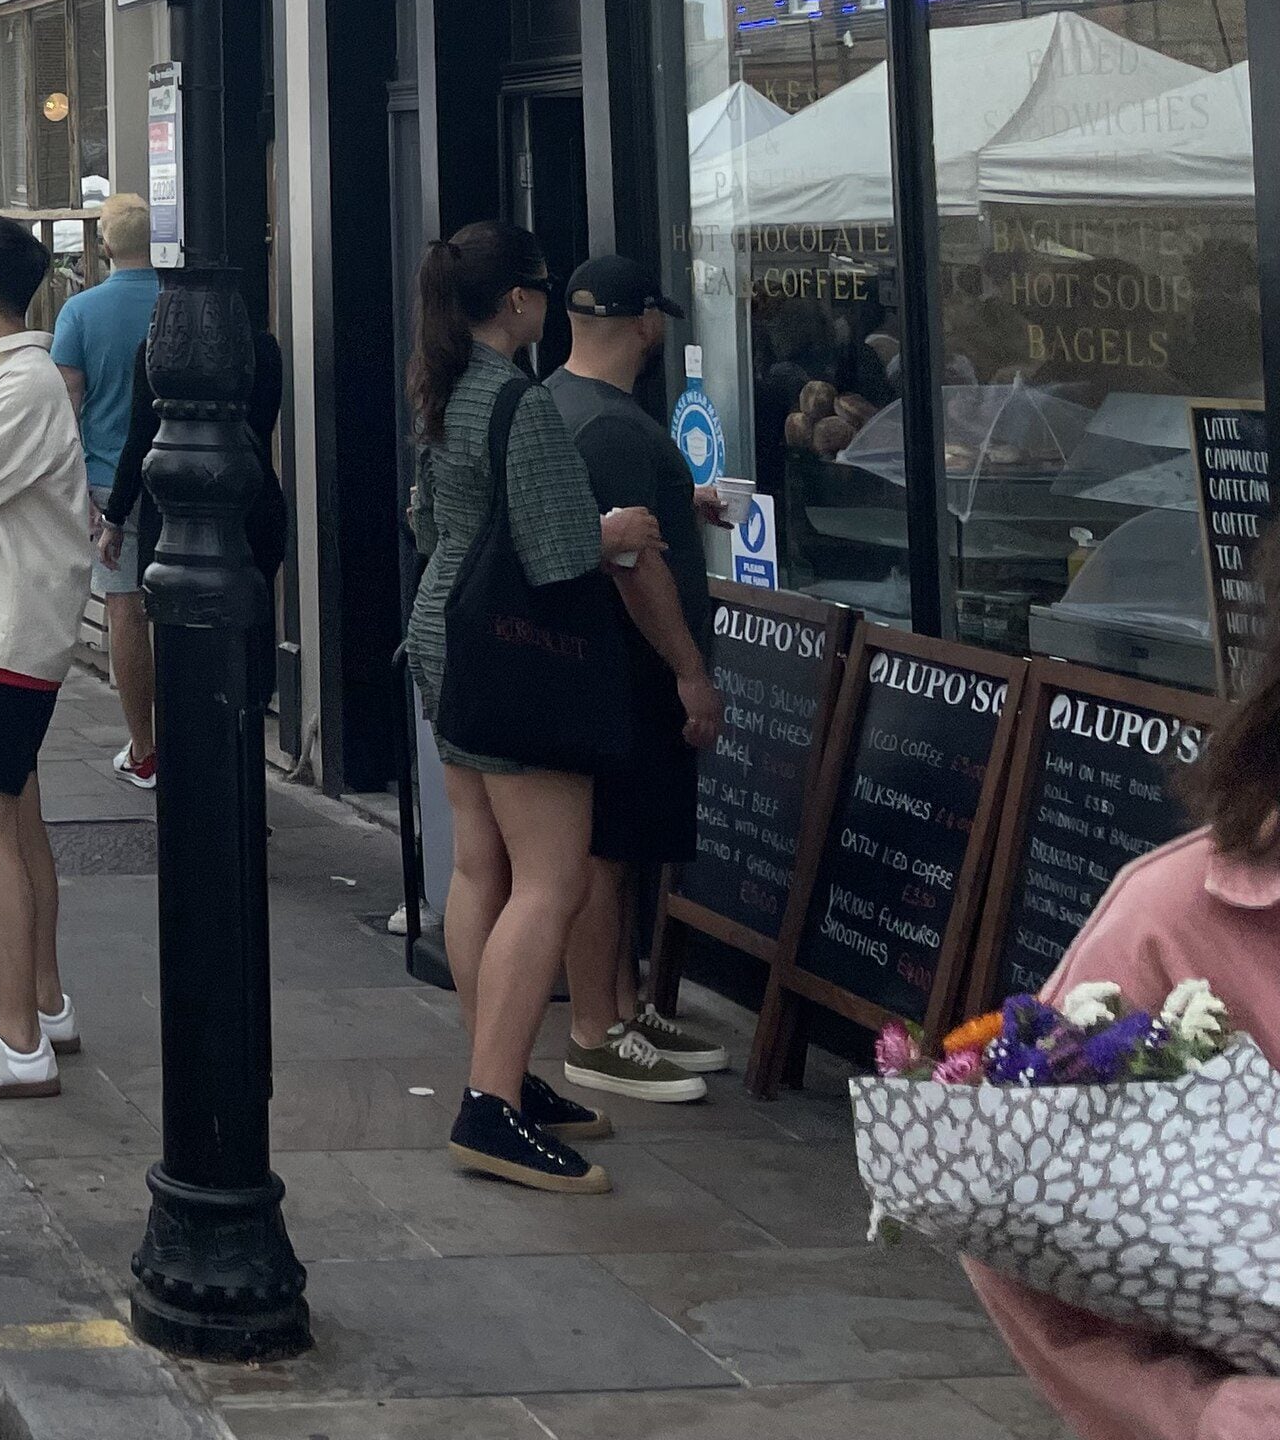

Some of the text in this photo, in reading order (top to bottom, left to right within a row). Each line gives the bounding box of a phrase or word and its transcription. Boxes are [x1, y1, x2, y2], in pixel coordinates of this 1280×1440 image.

[672, 223, 890, 254] HOT CHOCOLATE
[685, 267, 733, 296] TEA
[763, 268, 868, 301] COFFEE
[1011, 272, 1190, 312] HOT SOUP
[1028, 324, 1168, 368] BAGELS
[1203, 417, 1240, 440] LATTE
[1212, 511, 1260, 538] COFFEE
[743, 562, 766, 575] PLEASE
[1215, 544, 1243, 570] TEA
[729, 610, 814, 658] LUPO'S
[713, 666, 765, 704] SMOKED
[887, 657, 992, 713] LUPO'S
[724, 706, 813, 747] CREAM CHEES
[1071, 700, 1201, 764] LUPO'S
[716, 734, 753, 768] BAGEL
[869, 727, 898, 752] ICED
[901, 738, 945, 768] COFFEE
[697, 774, 779, 820] HOT SALT BEEF
[1043, 783, 1075, 805] ROLL
[1046, 751, 1163, 803] HAM ON THE BONE
[853, 774, 932, 821] MILKSHAKES
[696, 803, 730, 828] BAGEL
[734, 820, 759, 839] WITH
[1037, 806, 1089, 838] SANDWICH
[746, 854, 795, 889] GHERKINS
[841, 827, 954, 890] OATLY ICED COFFEE
[828, 883, 941, 948] VARIOUS FLAVOURED
[820, 915, 888, 966] SMOOTHIES
